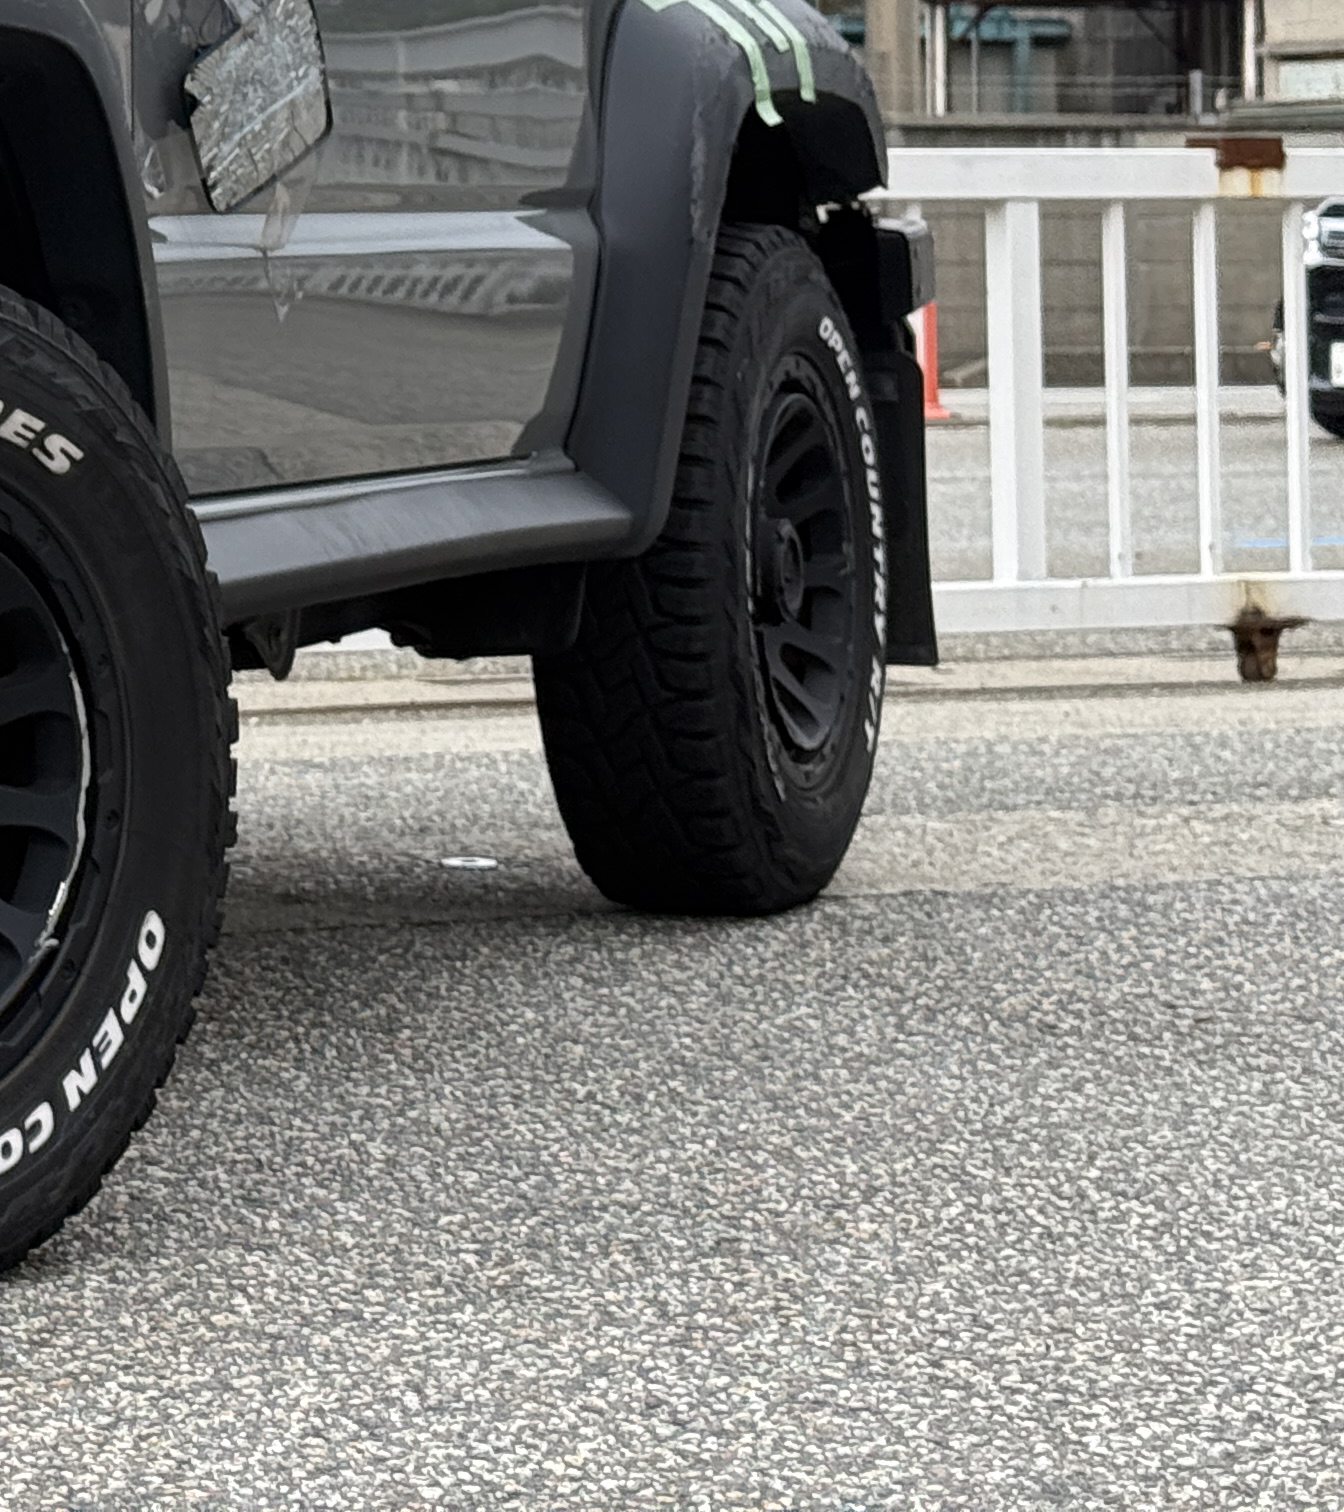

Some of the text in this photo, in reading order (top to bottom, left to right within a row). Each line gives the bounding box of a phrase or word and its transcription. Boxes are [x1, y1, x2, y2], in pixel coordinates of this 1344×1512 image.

[818, 315, 887, 753] OPEN COUNTRY R/T
[61, 909, 167, 1114] OPEN
